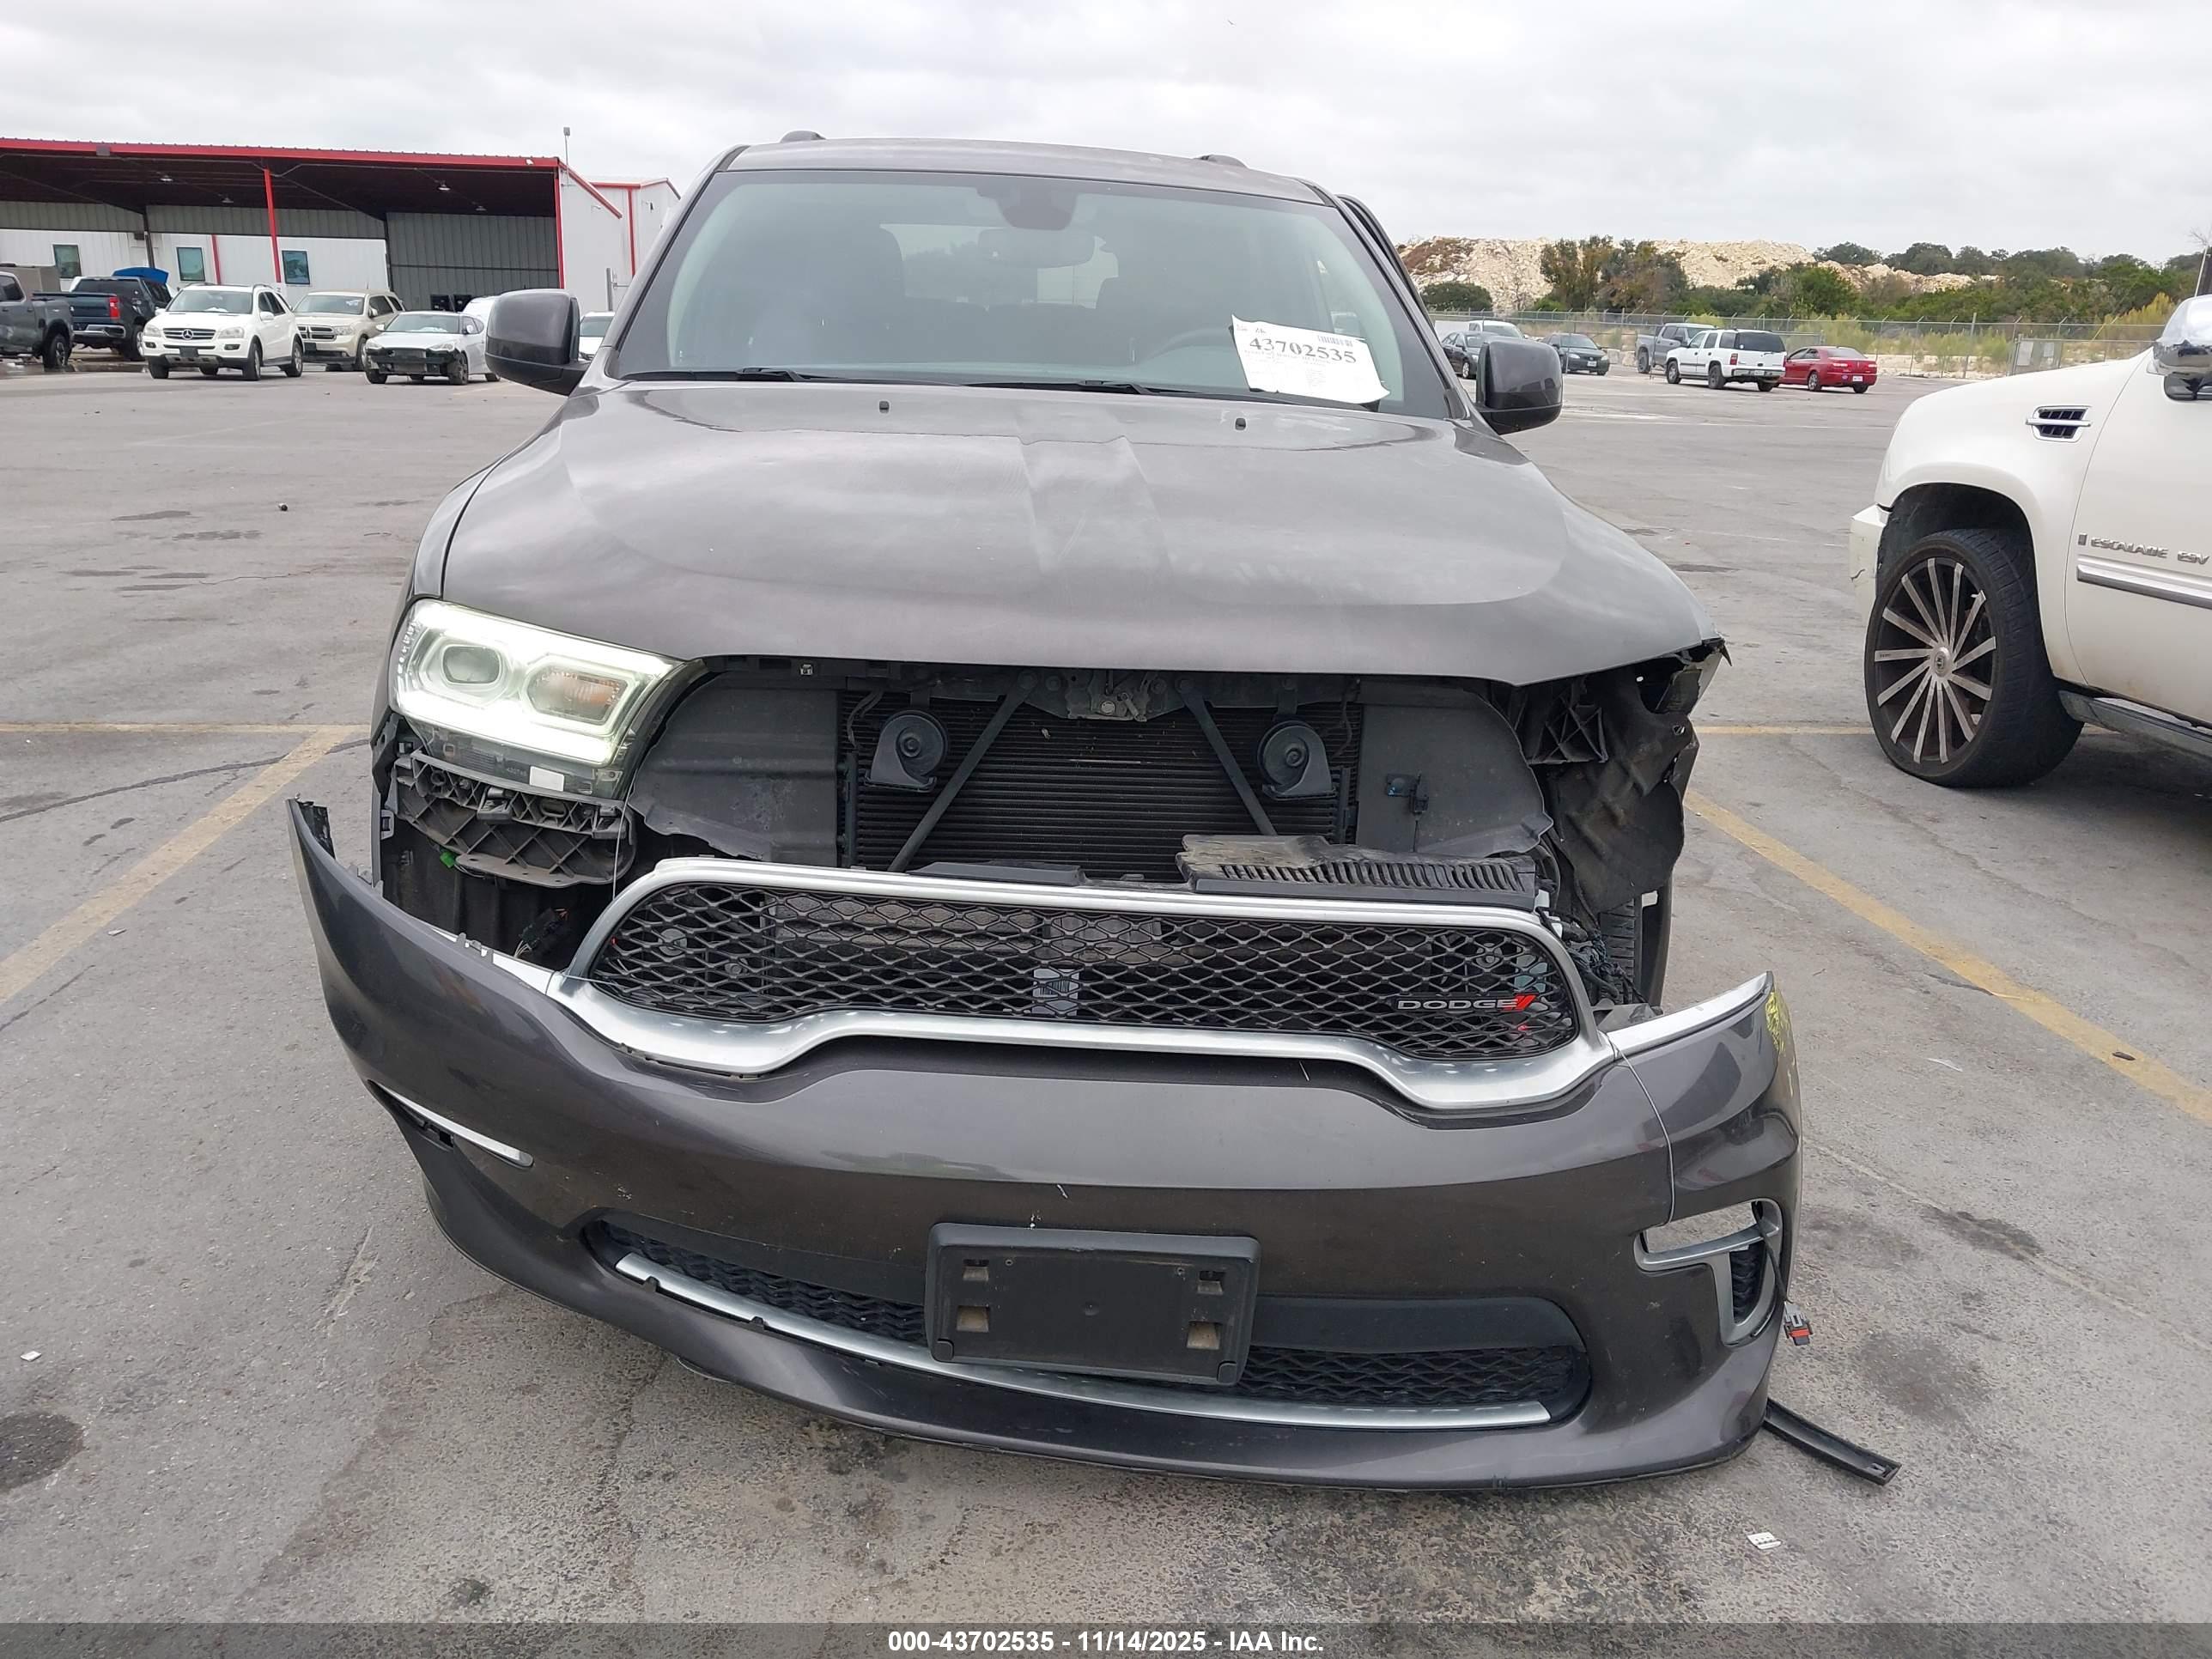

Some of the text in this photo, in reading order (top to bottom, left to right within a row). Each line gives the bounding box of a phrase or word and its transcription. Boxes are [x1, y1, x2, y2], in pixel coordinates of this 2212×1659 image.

[1249, 337, 1356, 363] 43702535
[2091, 538, 2210, 564] ESCALADE ESV
[1397, 999, 1519, 1011] DODGE
